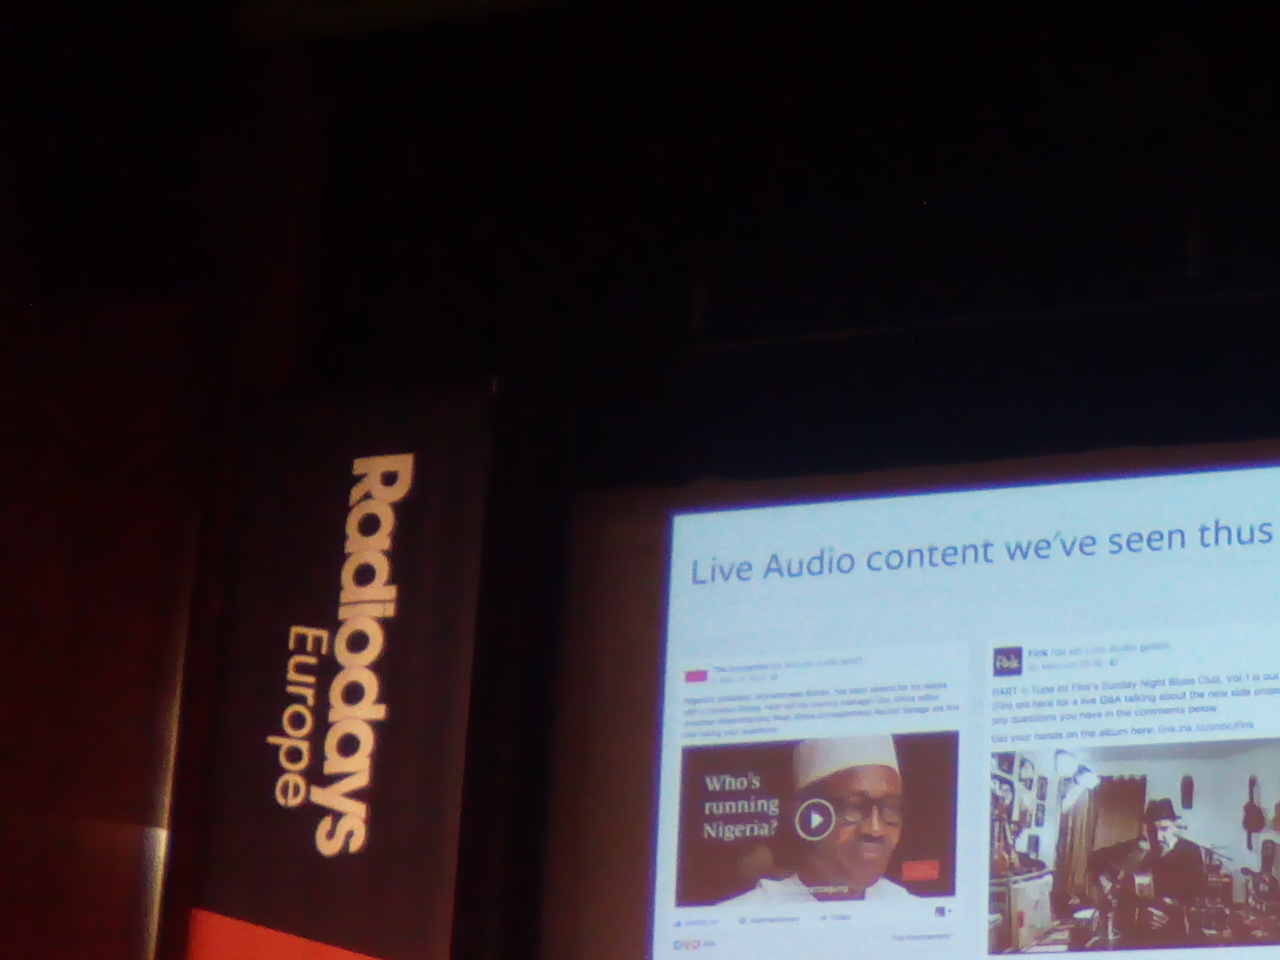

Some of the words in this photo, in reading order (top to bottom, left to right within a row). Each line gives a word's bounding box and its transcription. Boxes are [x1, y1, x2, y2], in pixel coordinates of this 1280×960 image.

[691, 558, 752, 585] Live
[763, 549, 855, 581] Audio
[866, 540, 993, 572] content
[1004, 530, 1097, 563] we've
[1107, 528, 1186, 555] seen
[1199, 518, 1272, 547] thus
[310, 453, 414, 857] Radiodays
[1101, 680, 1137, 690] Sunday
[1141, 679, 1166, 689] Night
[1252, 673, 1260, 682] is
[1263, 672, 1279, 681] out
[1033, 700, 1054, 708] here
[1081, 697, 1097, 705] live
[1100, 695, 1121, 704] Q&A
[1124, 694, 1156, 703] talking
[1159, 692, 1186, 700] about
[1190, 690, 1204, 699] the
[1208, 689, 1228, 698] new
[1231, 687, 1251, 697] side
[266, 626, 328, 809] Europe
[992, 717, 1008, 726] any
[1011, 714, 1056, 724] questions
[1060, 713, 1077, 722] you
[1080, 711, 1102, 720] have
[1105, 709, 1114, 717] in
[1116, 709, 1131, 718] the
[1135, 707, 1185, 716] comments
[1011, 734, 1031, 743] your
[1034, 732, 1063, 740] hands
[1066, 731, 1078, 739] on
[1080, 729, 1096, 738] the
[1099, 727, 1128, 737] album
[704, 772, 760, 792] Who's
[704, 798, 779, 816] running
[703, 822, 778, 842] Nigeria?
